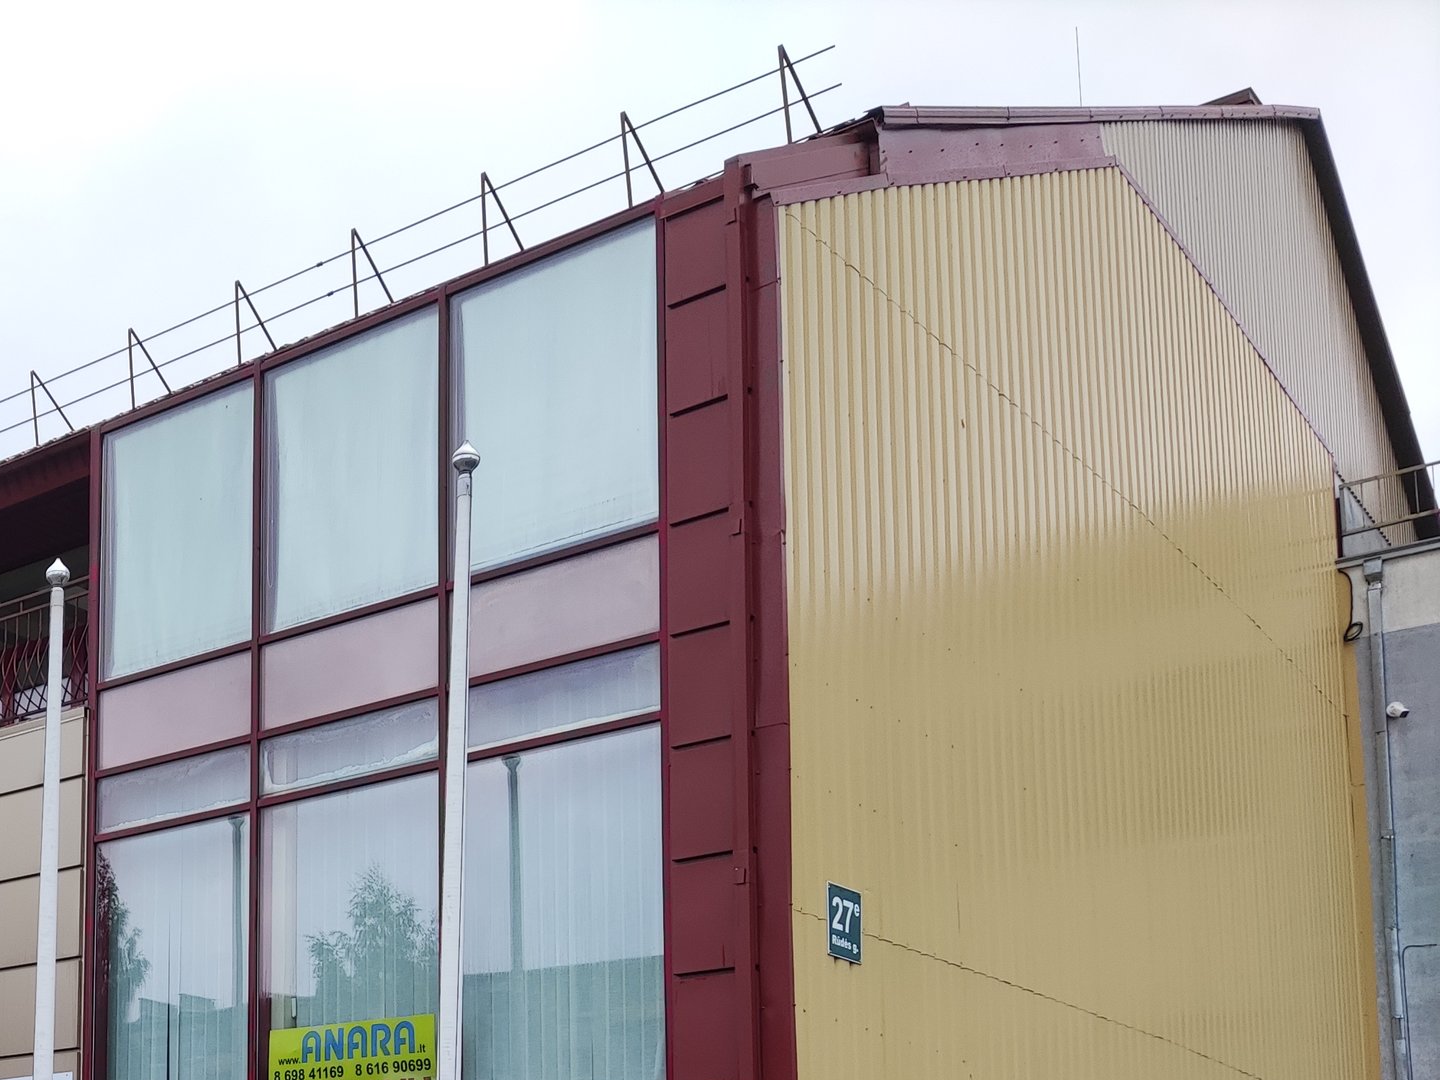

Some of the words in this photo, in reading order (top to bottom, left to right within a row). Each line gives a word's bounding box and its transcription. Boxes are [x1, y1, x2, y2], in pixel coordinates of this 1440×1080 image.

[309, 1065, 344, 1080] 41169
[355, 1064, 362, 1076] 8
[366, 1062, 389, 1075] 616
[392, 1058, 431, 1073] 90699
